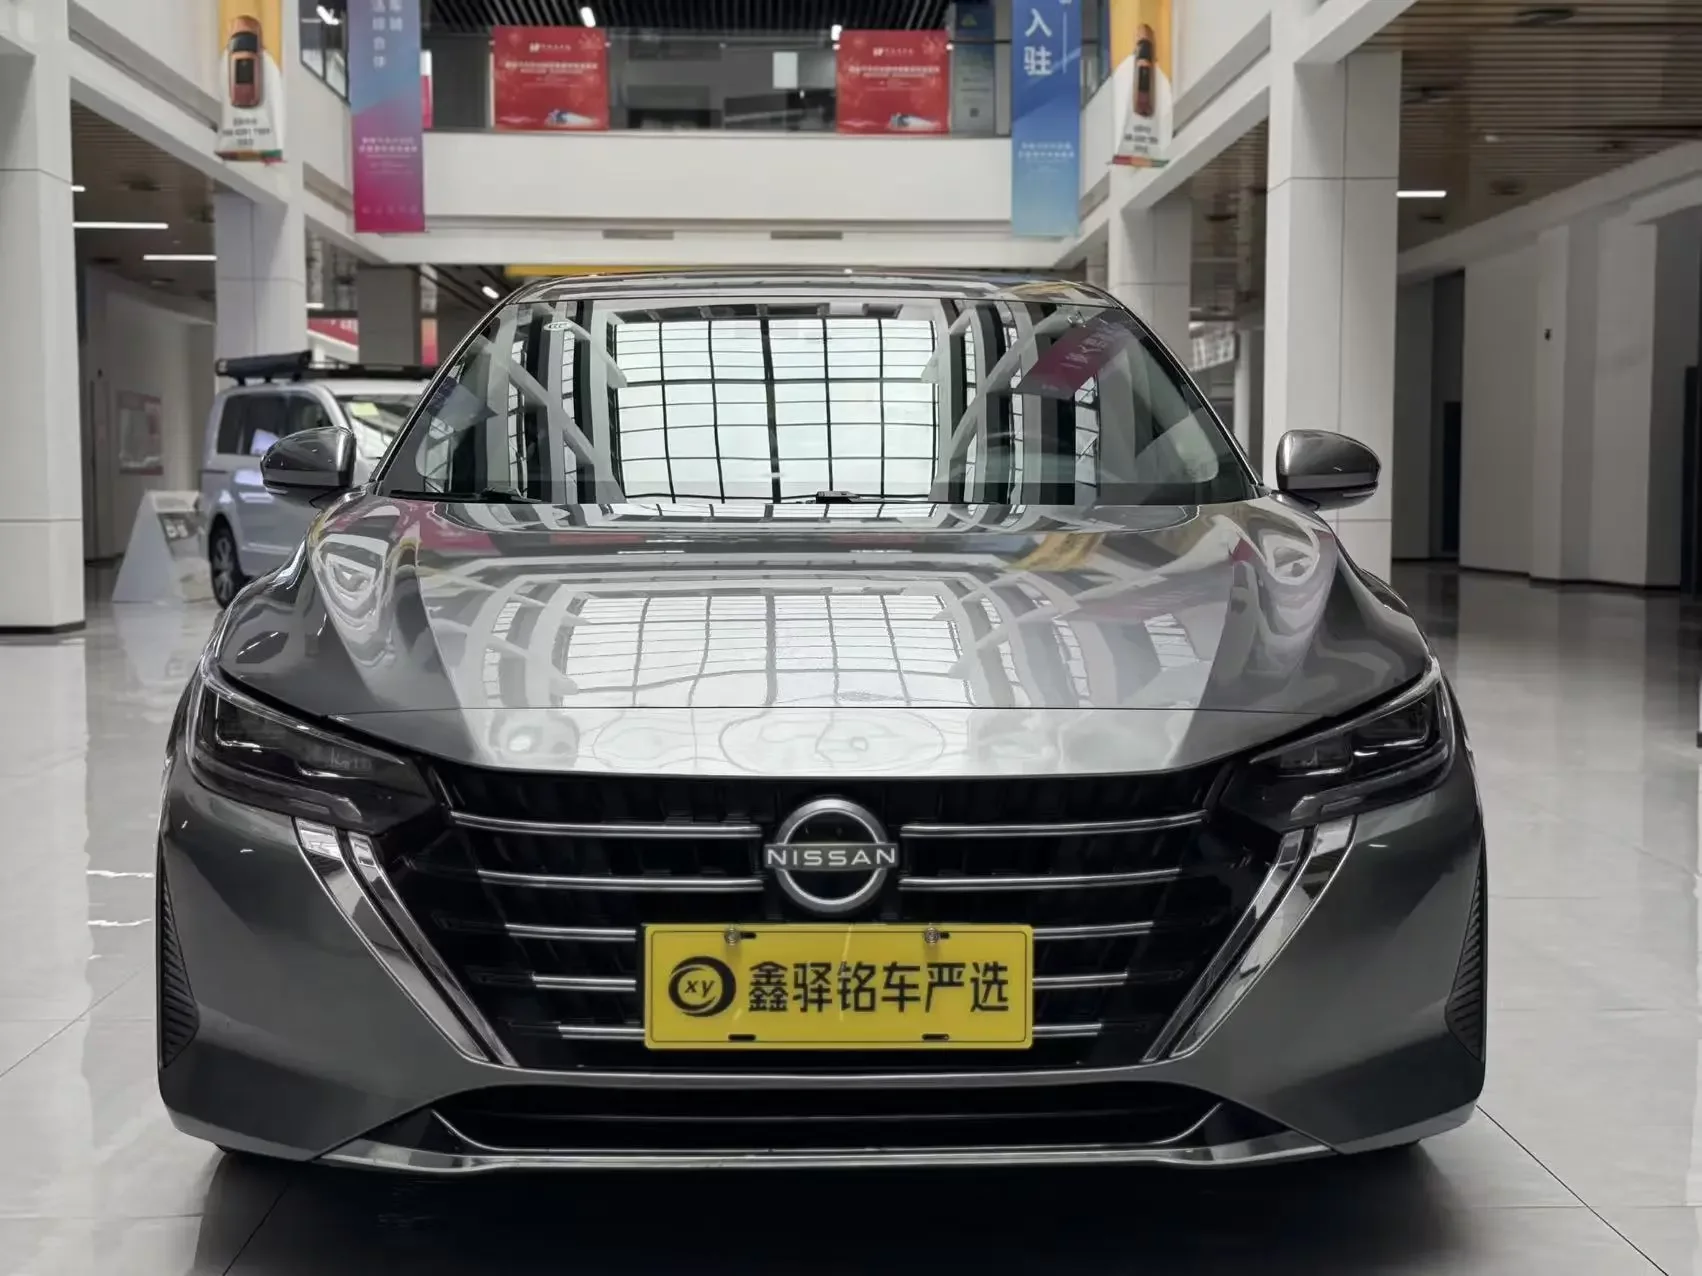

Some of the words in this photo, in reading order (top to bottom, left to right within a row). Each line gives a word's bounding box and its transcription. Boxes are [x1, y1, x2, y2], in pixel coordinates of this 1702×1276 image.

[1024, 8, 1053, 76] 入驻
[767, 848, 895, 866] NISSAN
[748, 961, 1009, 1013] 鑫驿铭车严选
